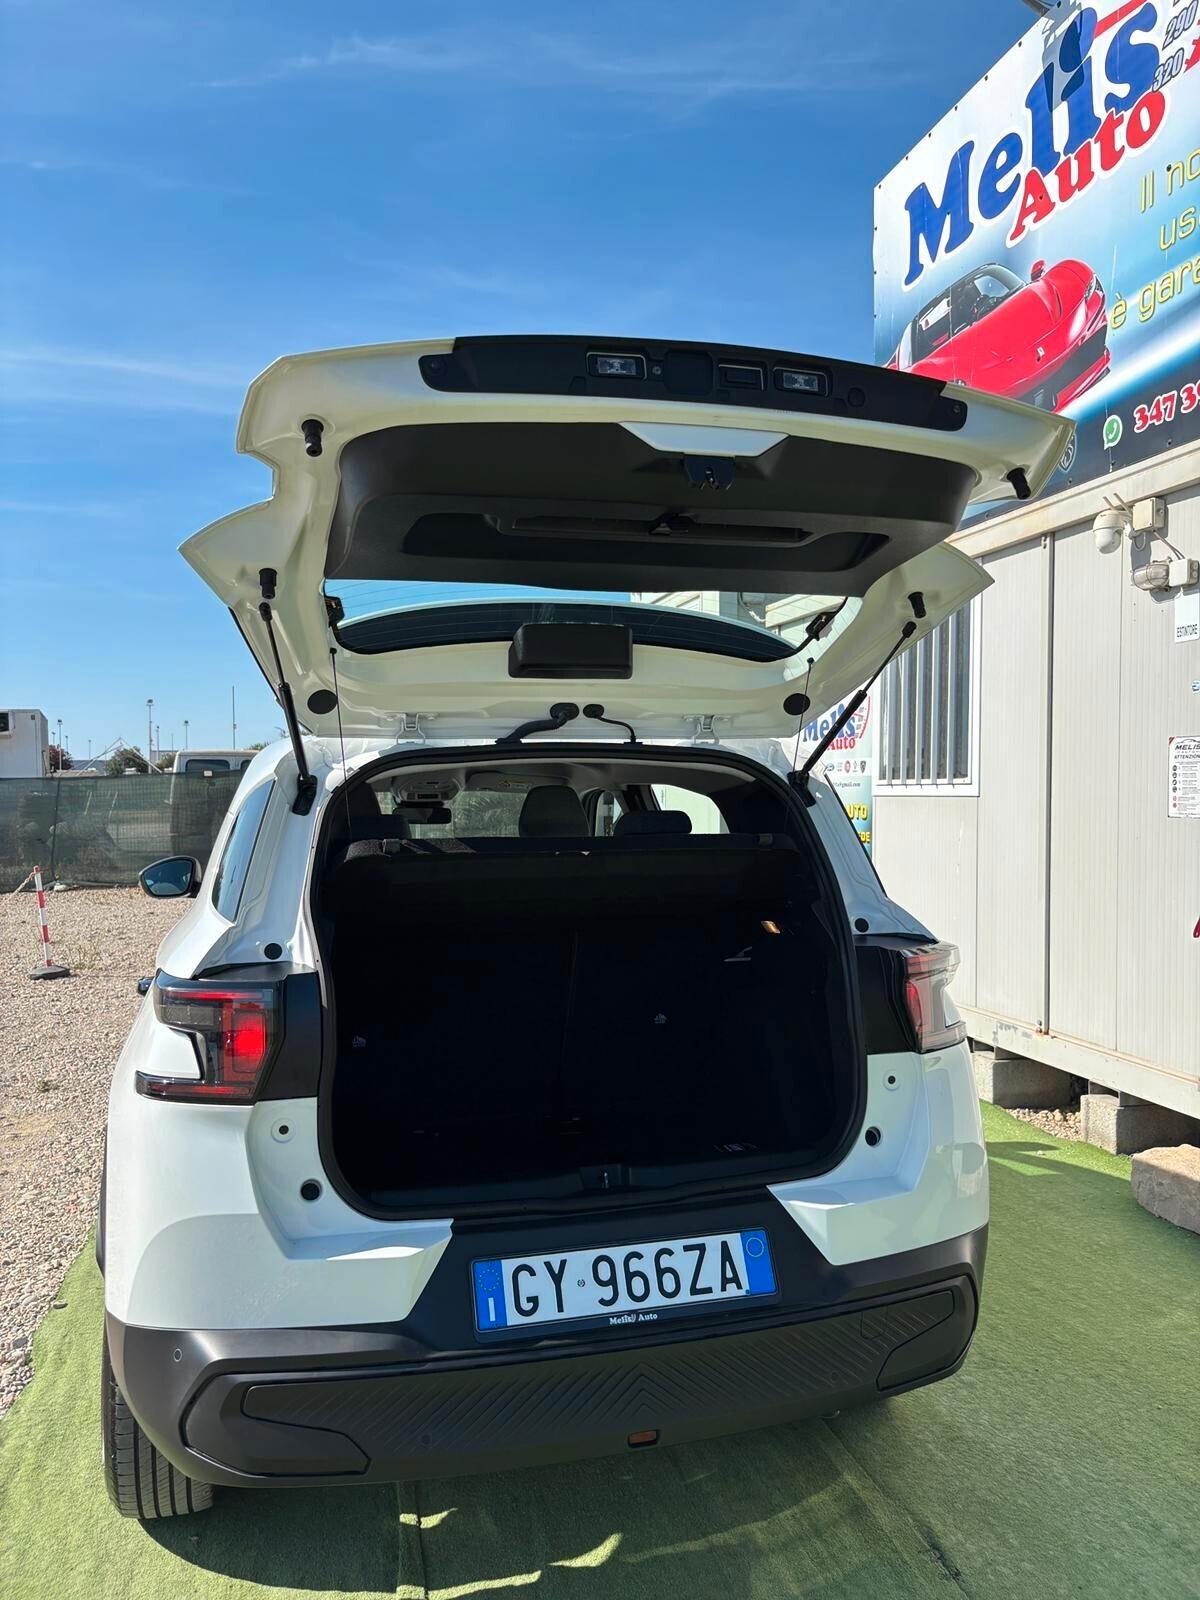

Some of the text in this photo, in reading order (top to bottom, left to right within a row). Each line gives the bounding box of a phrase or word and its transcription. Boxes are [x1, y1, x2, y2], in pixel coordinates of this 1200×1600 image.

[1162, 0, 1199, 50] 290
[1152, 47, 1185, 93] 320
[903, 2, 1160, 287] Melis
[1009, 91, 1166, 243] Auto
[1140, 170, 1155, 214] Il
[1159, 205, 1200, 251] us
[1110, 292, 1128, 330] è
[1133, 380, 1200, 433] 347 3
[845, 803, 868, 821] UTO
[511, 1258, 568, 1318] GY
[590, 1239, 744, 1308] 966ZA
[638, 1312, 658, 1321] Auto
